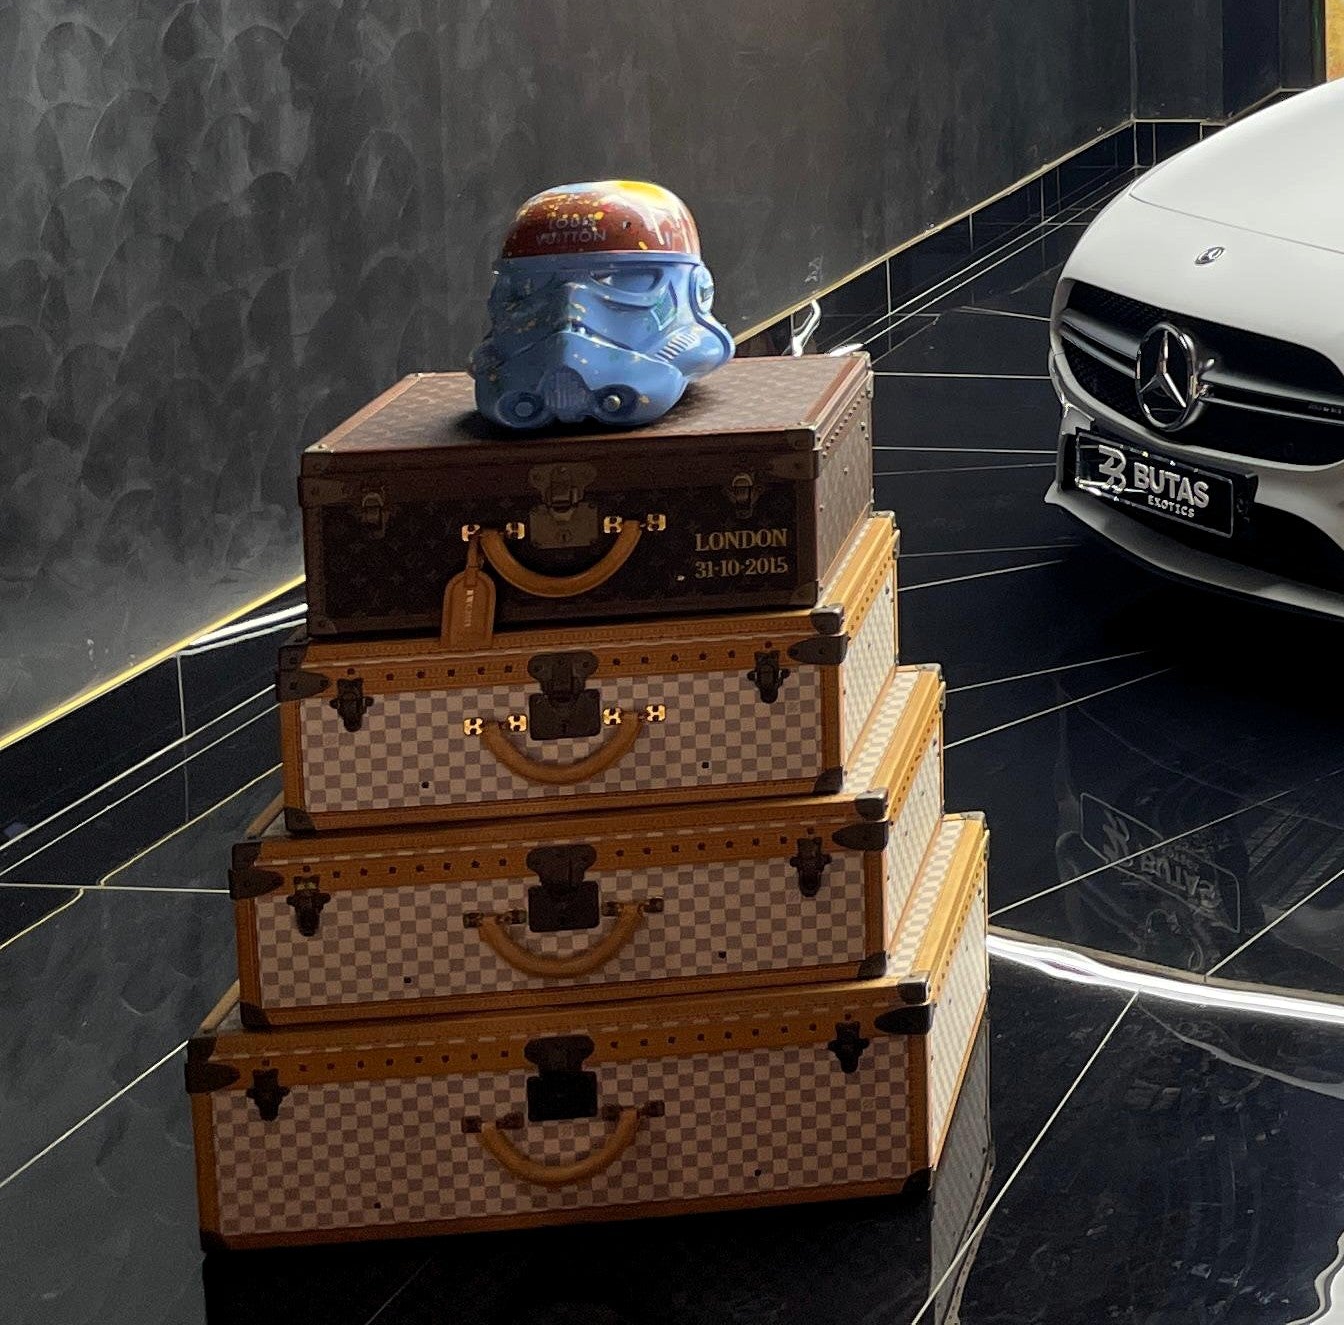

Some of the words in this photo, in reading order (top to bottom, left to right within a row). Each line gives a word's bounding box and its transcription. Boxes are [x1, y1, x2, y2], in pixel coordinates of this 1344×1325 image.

[1133, 462, 1210, 509] BUTAS
[1147, 494, 1195, 518] EXOTICS
[695, 528, 788, 552] LONDON
